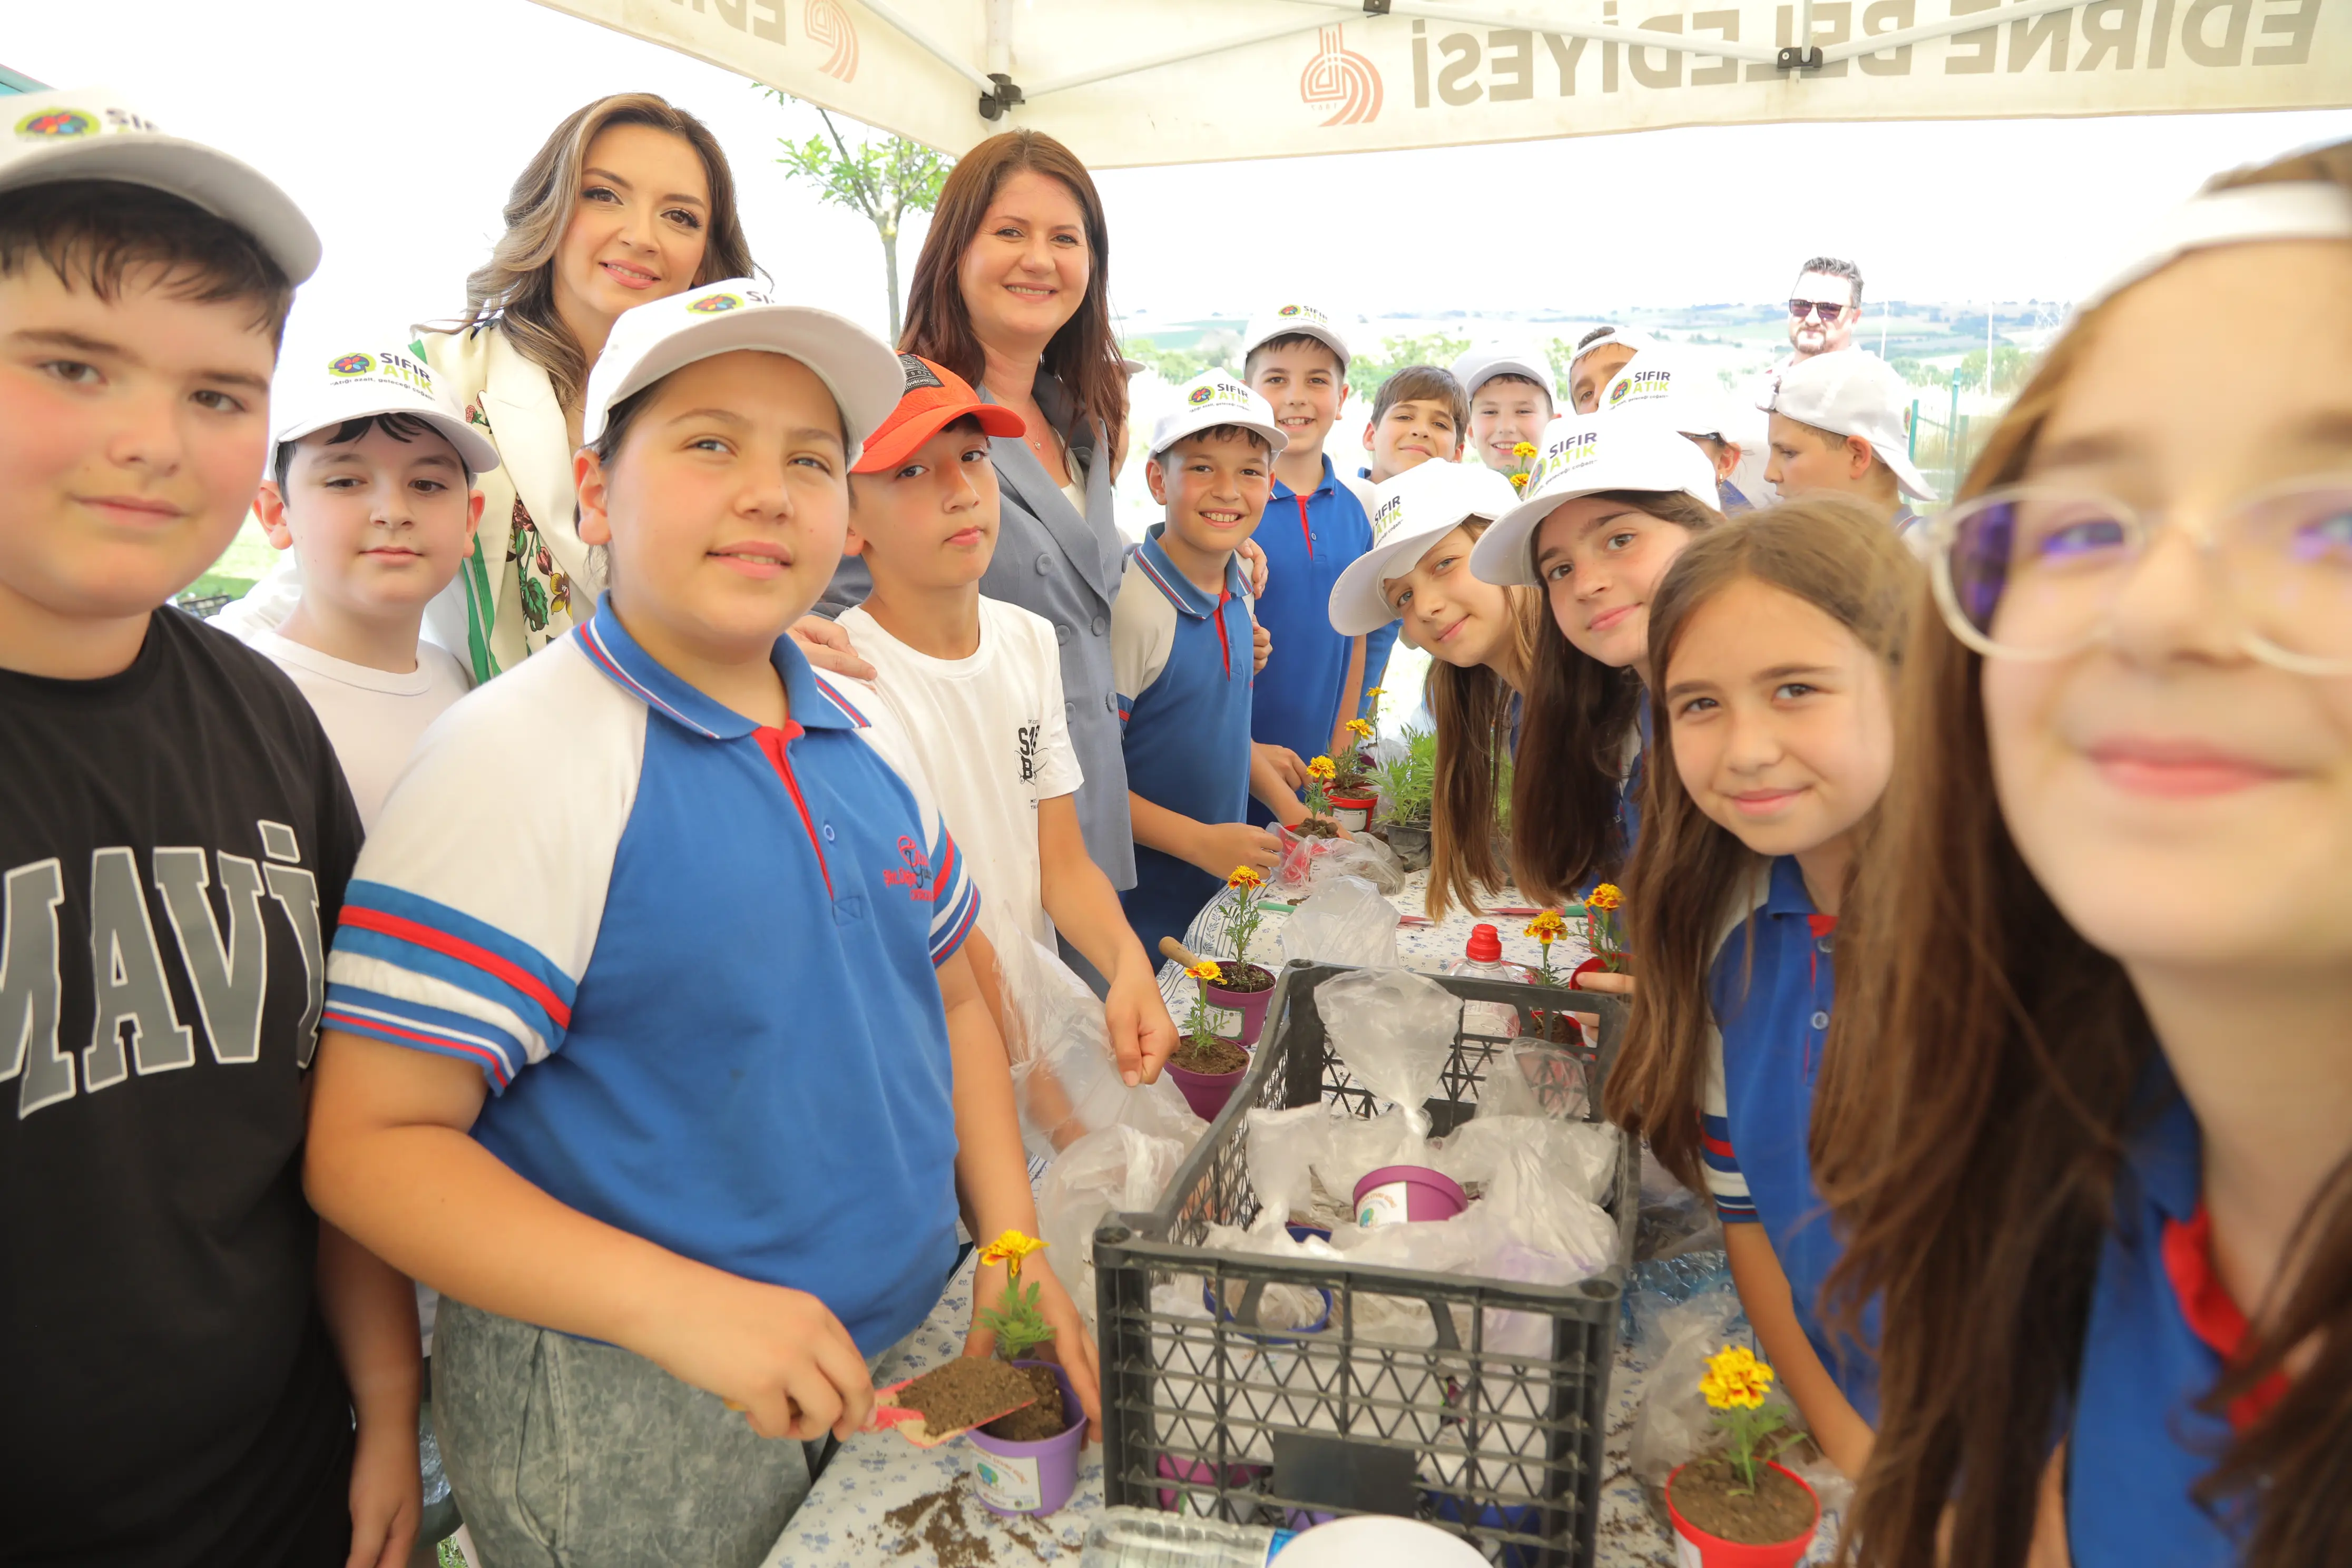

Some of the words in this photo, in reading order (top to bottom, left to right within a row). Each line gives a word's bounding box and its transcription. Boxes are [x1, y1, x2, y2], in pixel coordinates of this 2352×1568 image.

[380, 352, 432, 383] SIFIR
[383, 364, 434, 395] ATIK
[1634, 370, 1671, 383] SIFIR
[907, 378, 930, 387] QUECHUA
[1217, 383, 1249, 399] SIFIR
[1632, 380, 1669, 394] ATIK
[1218, 391, 1250, 406] ATIK
[1549, 432, 1598, 459] SIFIR
[1550, 443, 1596, 473] ATIK
[1375, 495, 1401, 526] SIFIR
[1376, 505, 1402, 538] ATIK
